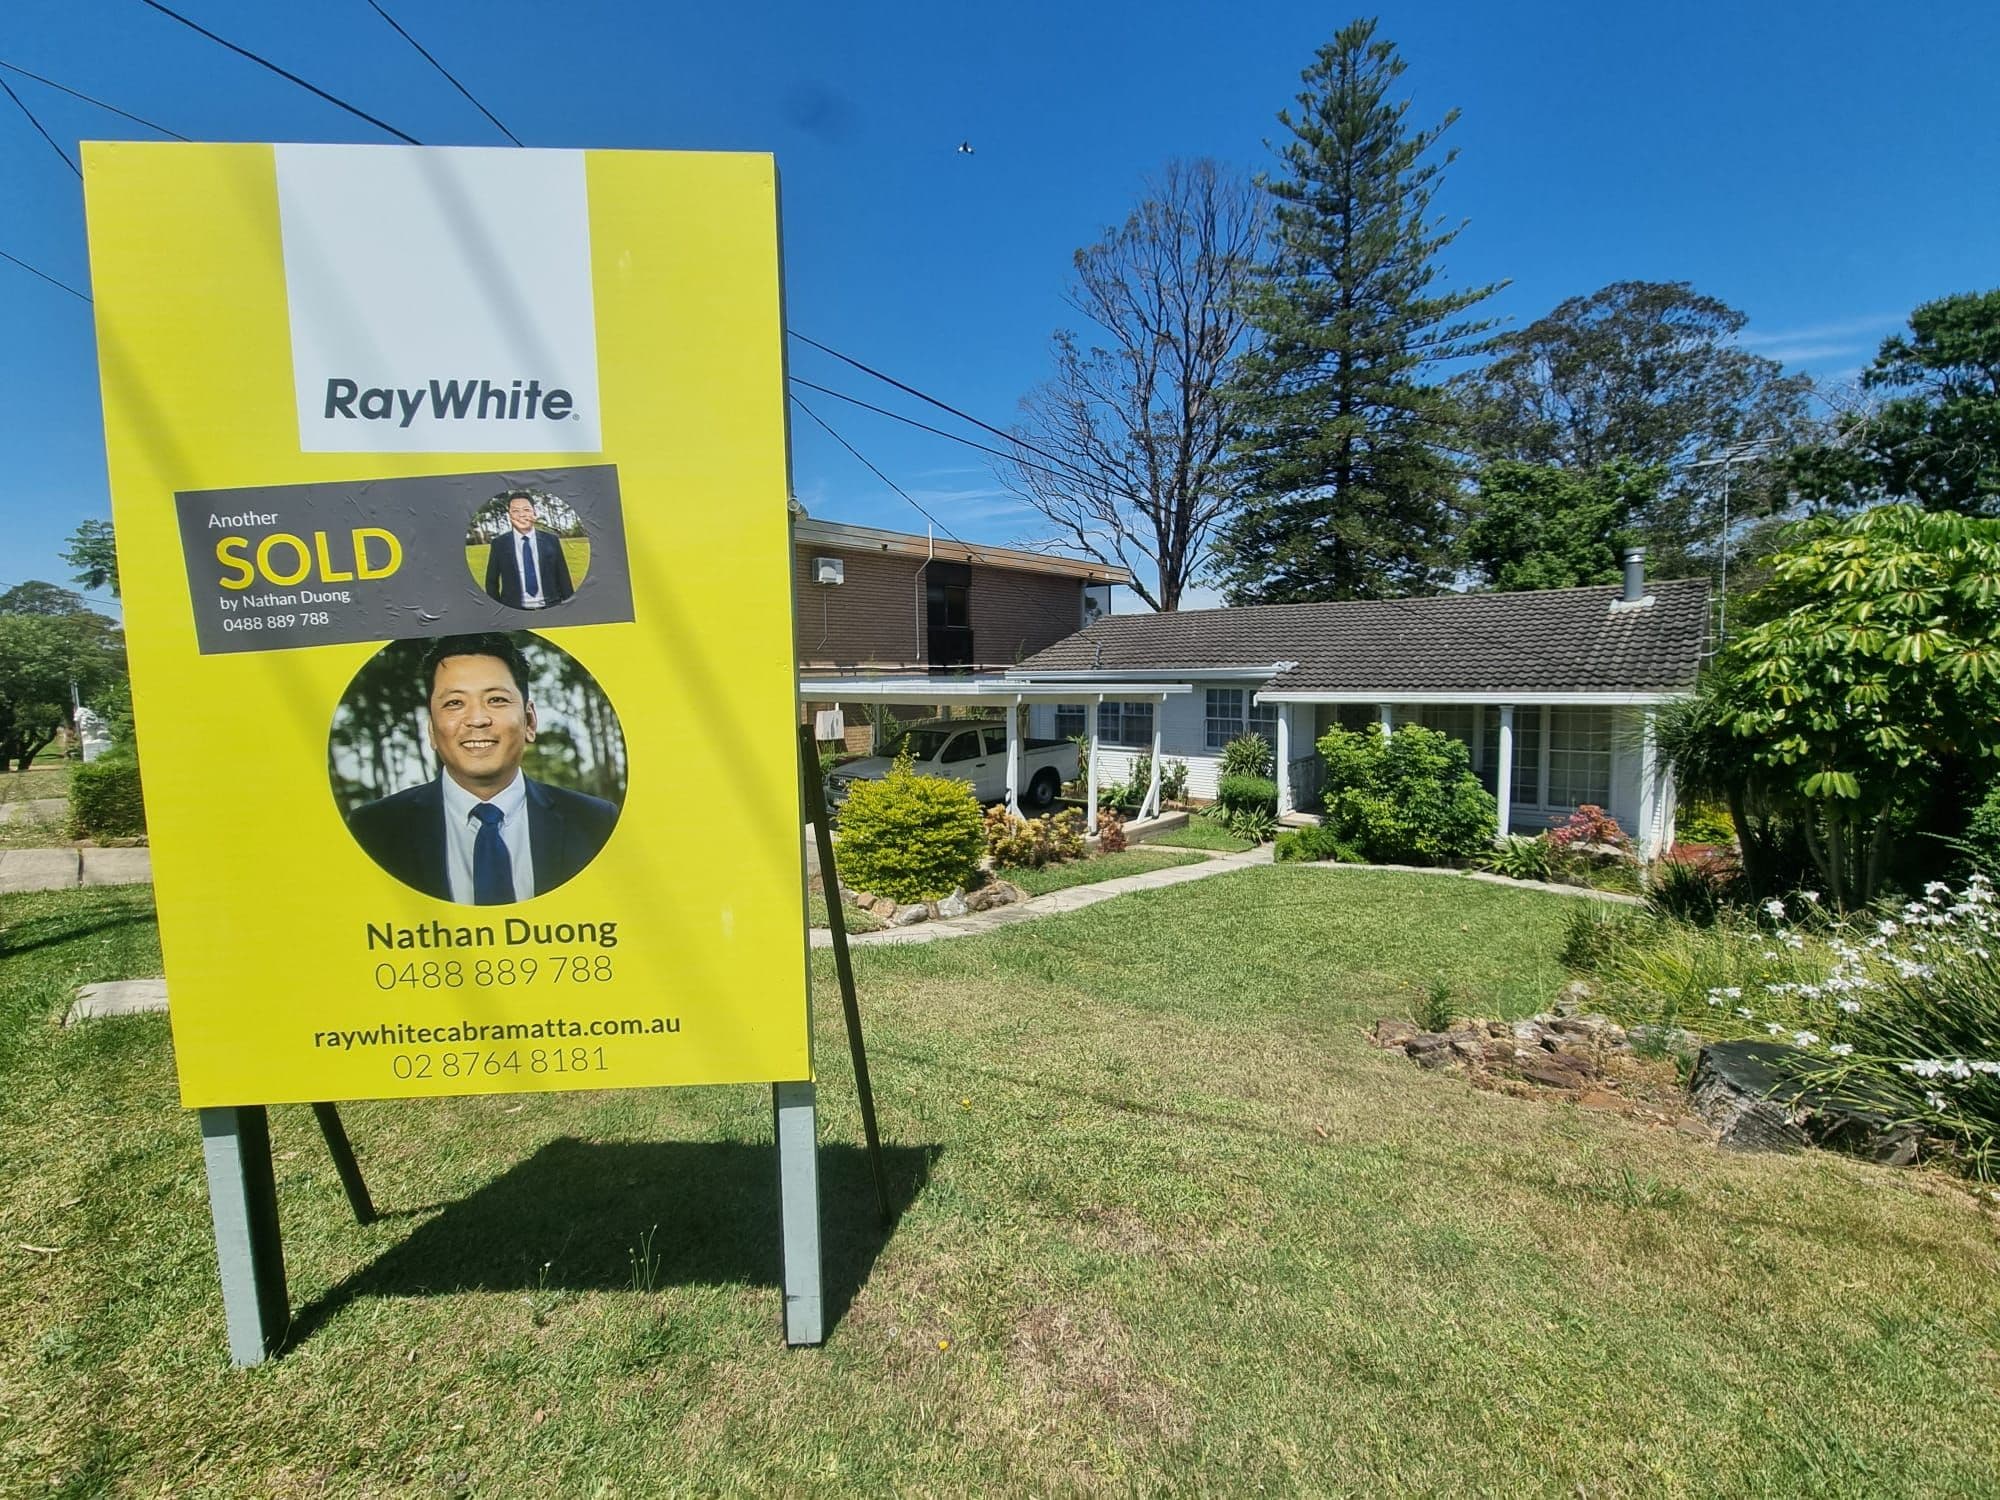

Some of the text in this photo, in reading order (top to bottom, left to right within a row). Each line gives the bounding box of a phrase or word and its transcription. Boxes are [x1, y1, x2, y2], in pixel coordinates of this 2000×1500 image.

[207, 510, 279, 530] Another
[215, 526, 404, 590] SOLD
[219, 589, 351, 612] by Nathan Duong
[223, 610, 330, 632] 0488 889 788
[366, 917, 618, 951] Nathan Duong
[375, 955, 613, 990] 0488 889 788
[314, 1016, 681, 1051] raywhitecabramatta.com.au
[392, 1046, 609, 1080] 02 8764 8181
